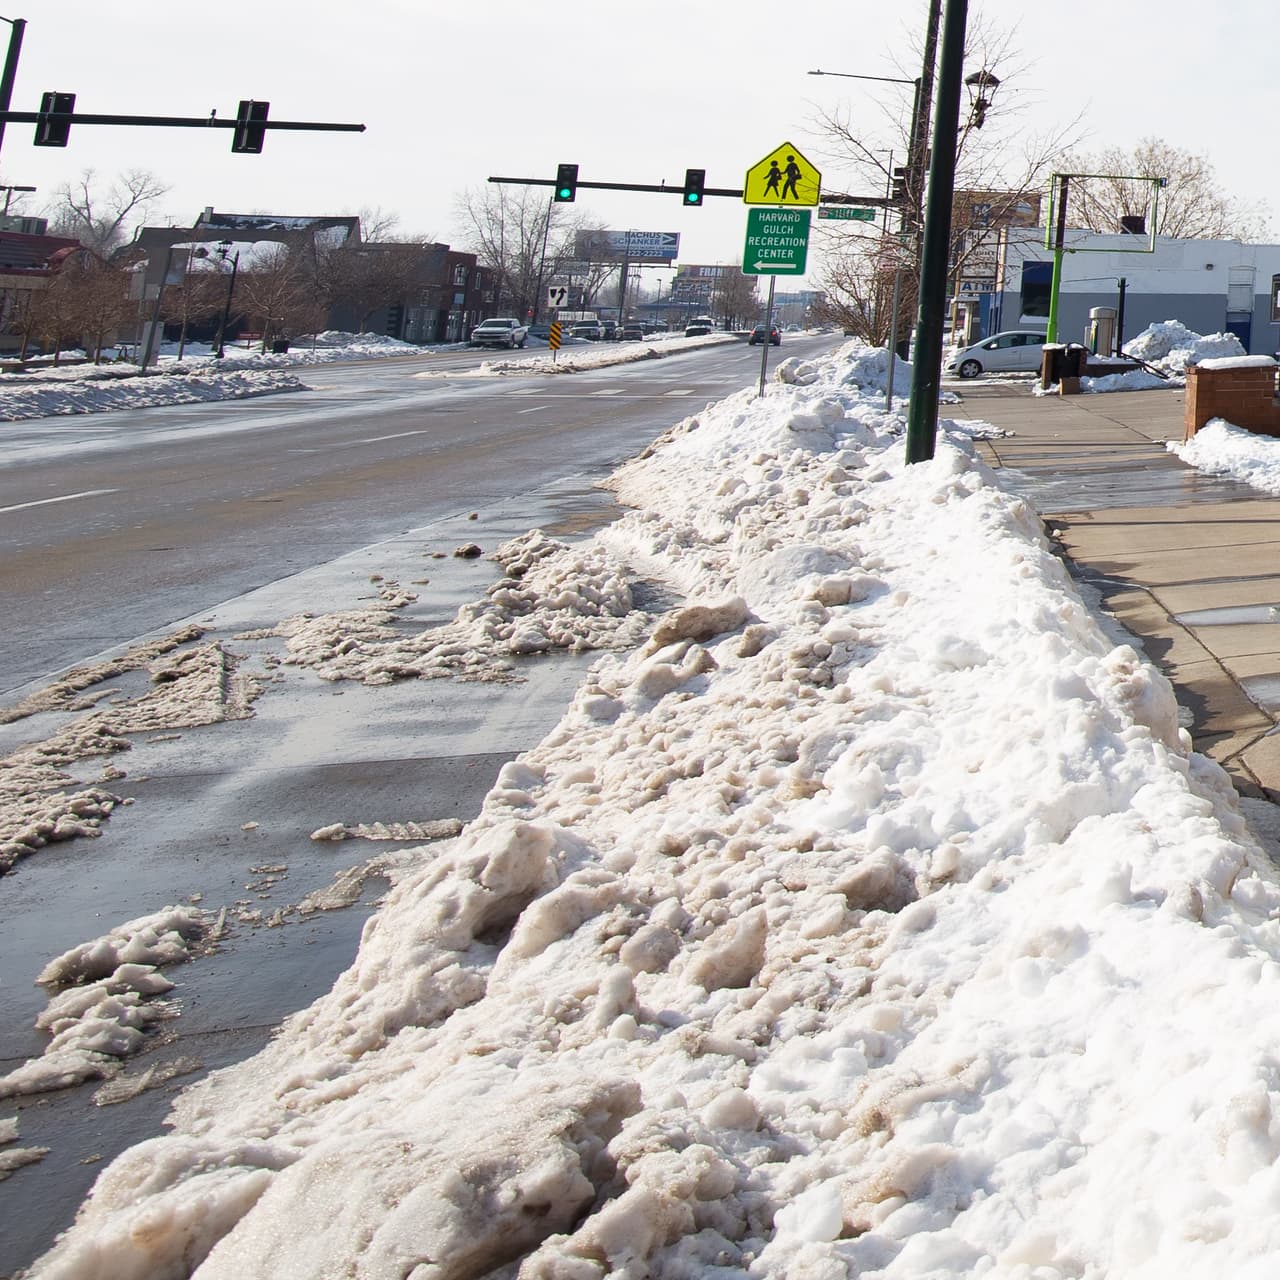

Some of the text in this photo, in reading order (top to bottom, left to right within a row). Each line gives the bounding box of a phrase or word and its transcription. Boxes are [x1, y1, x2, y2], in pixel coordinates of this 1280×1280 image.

[759, 213, 800, 222] HARVARD
[763, 225, 794, 234] GULCH
[748, 237, 806, 246] RECREATION
[757, 249, 794, 258] CENTER
